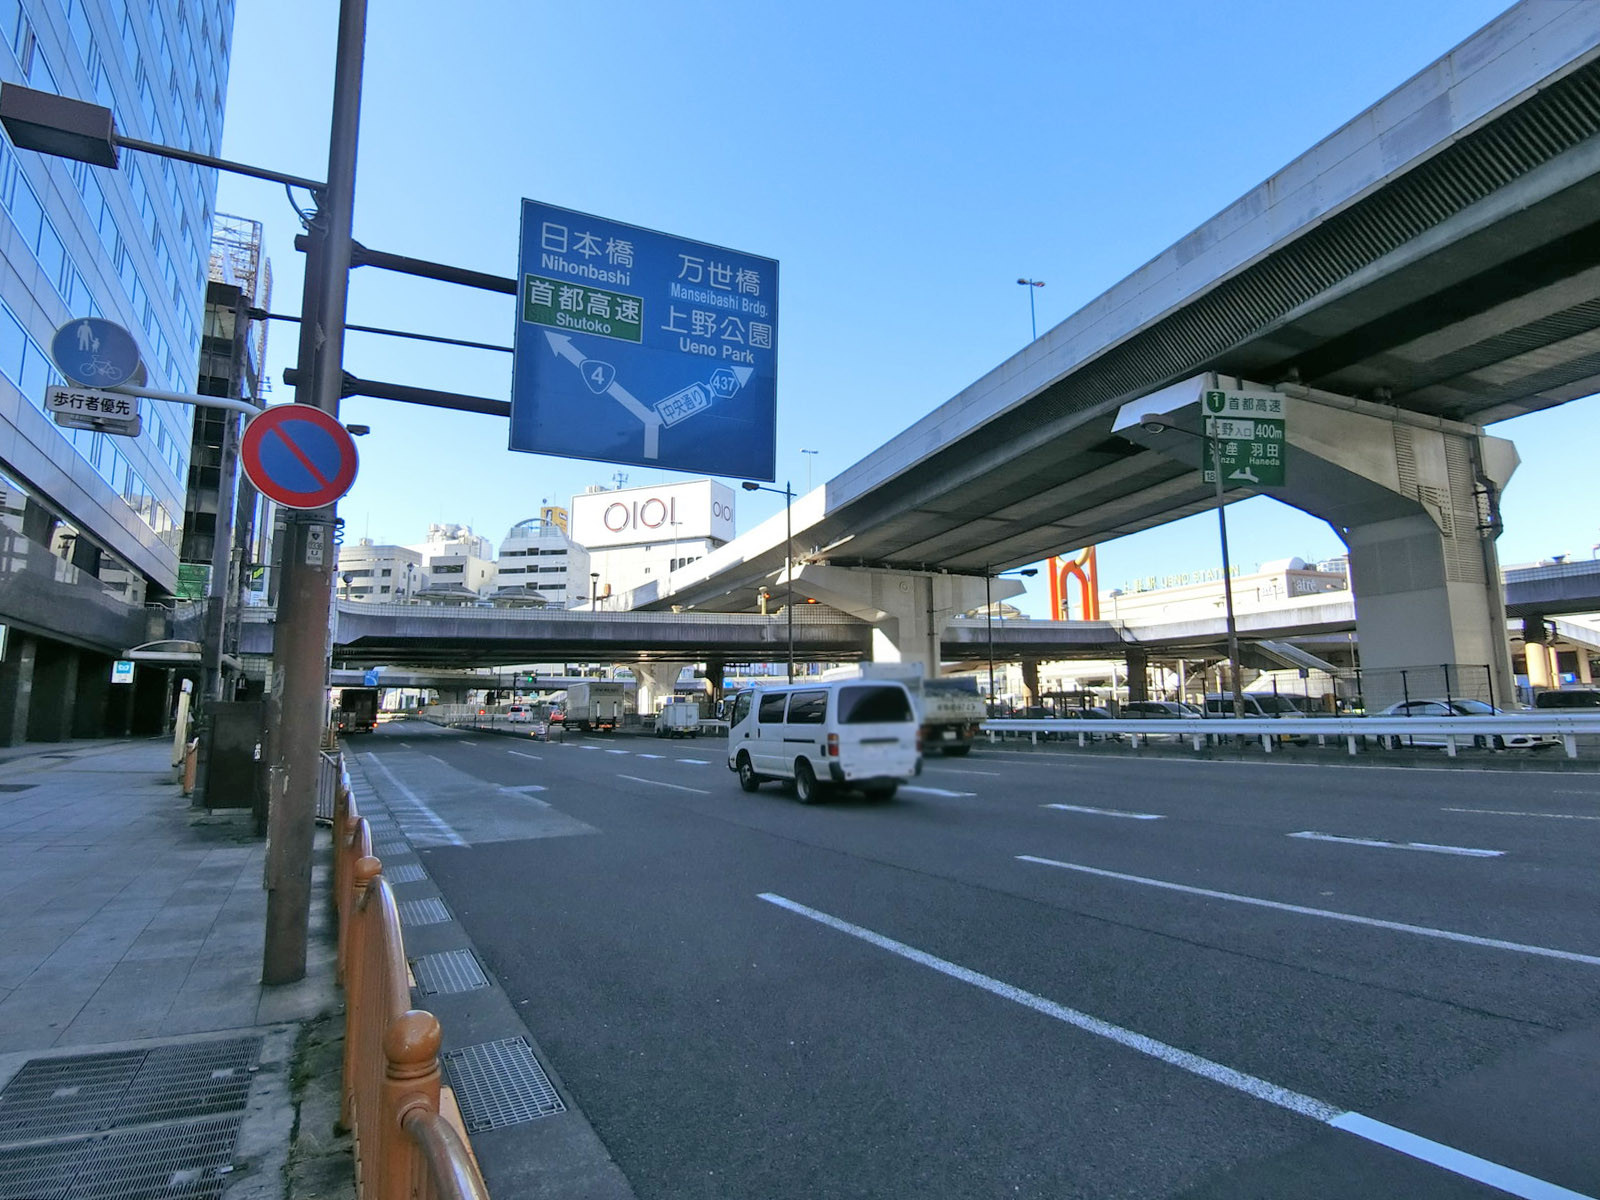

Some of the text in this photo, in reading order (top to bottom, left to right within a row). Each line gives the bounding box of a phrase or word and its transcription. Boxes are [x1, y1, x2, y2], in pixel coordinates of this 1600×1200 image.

[541, 221, 634, 268] 日本橋
[541, 254, 630, 286] Nihonbashi
[678, 253, 760, 296] 万世橋
[529, 280, 640, 324] 首都高速
[671, 282, 768, 317] Manseibashi Brdg.
[556, 312, 611, 334] Shutoko
[661, 305, 771, 349] 上野公園
[679, 337, 754, 364] Ueno Park
[591, 366, 604, 384] 4
[713, 375, 735, 391] 437
[53, 392, 130, 416] 歩行者優先
[663, 392, 703, 420] 中央通り
[1229, 397, 1281, 413] 首都高速
[1255, 424, 1282, 439] 400m
[1249, 457, 1280, 466] Haneda
[1250, 442, 1279, 457] 羽田
